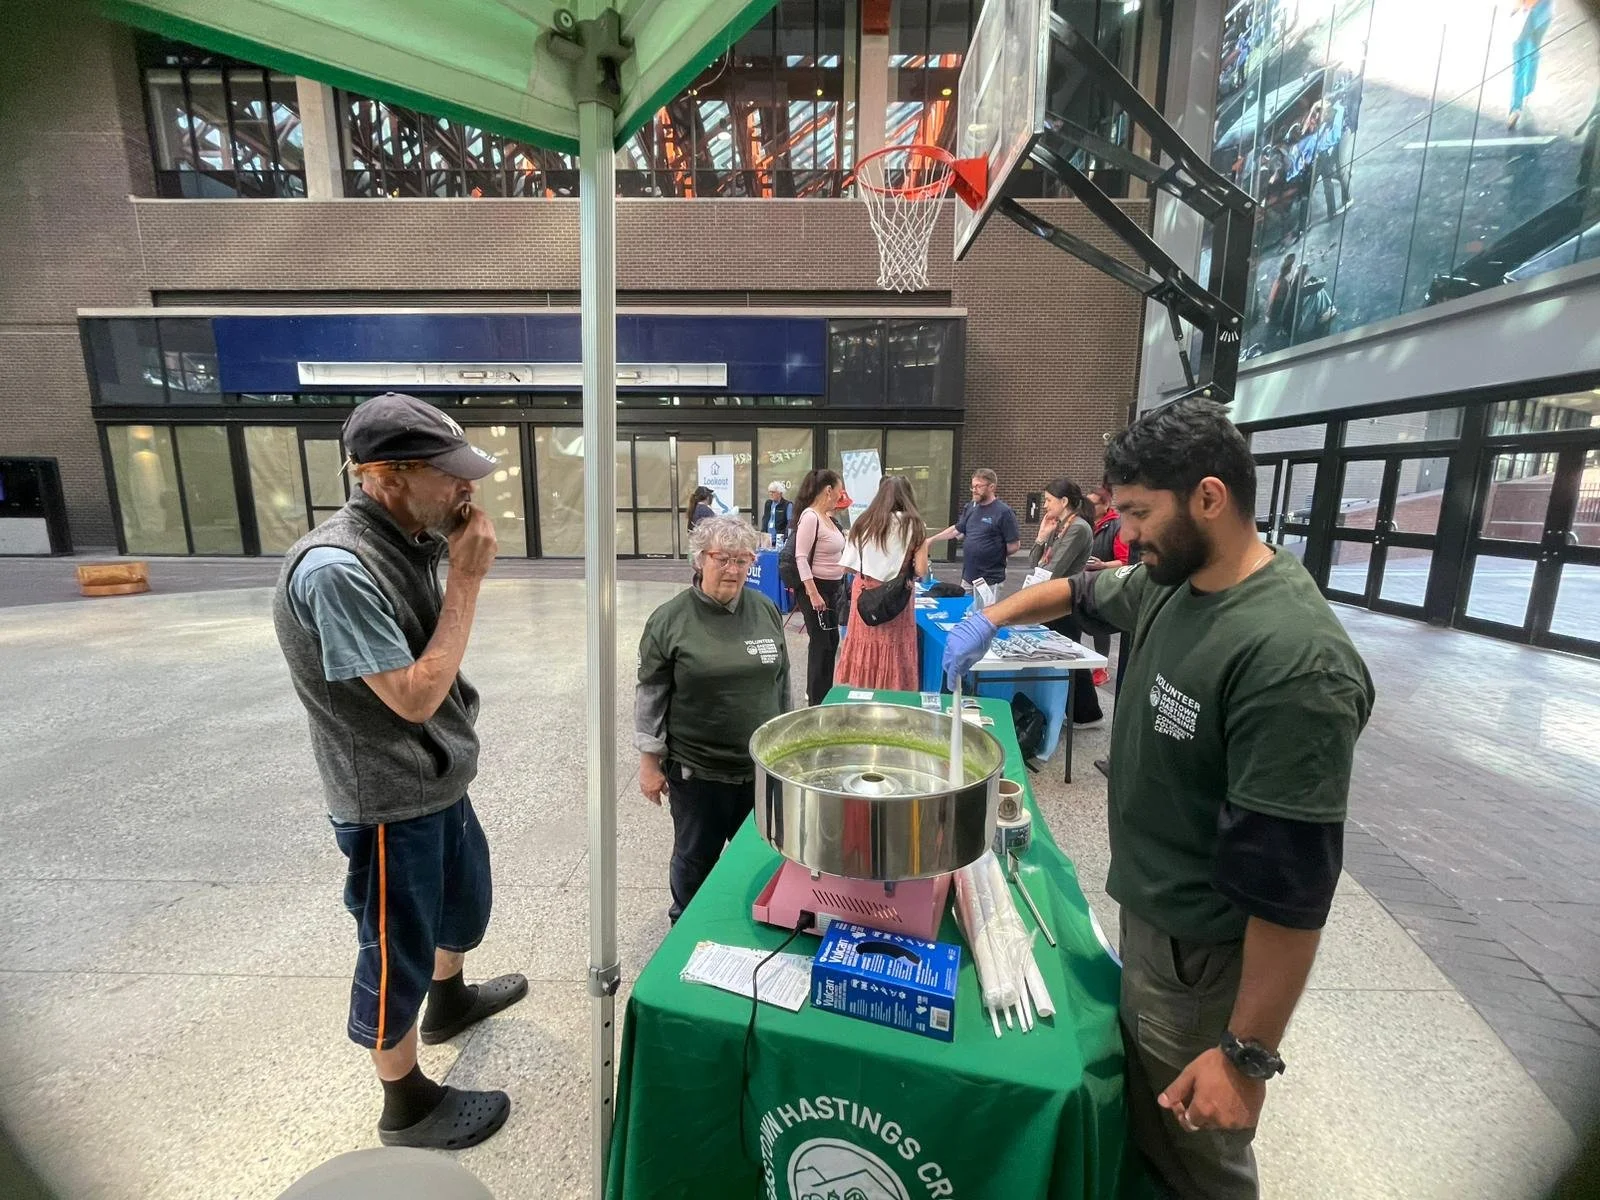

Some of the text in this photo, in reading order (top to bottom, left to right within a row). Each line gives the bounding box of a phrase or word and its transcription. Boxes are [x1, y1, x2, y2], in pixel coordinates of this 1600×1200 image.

[703, 476, 729, 486] Lookout
[746, 565, 762, 578] out
[1156, 673, 1200, 711] VOLUNTEER
[1158, 706, 1196, 732] CROSSING
[1159, 699, 1196, 726] HASTINGS
[1161, 693, 1198, 719] GASTOWN
[828, 938, 848, 963] Vulcan
[823, 978, 835, 1007] Vulcan
[776, 1095, 921, 1160] HASTINGS
[917, 1161, 954, 1200] CR
